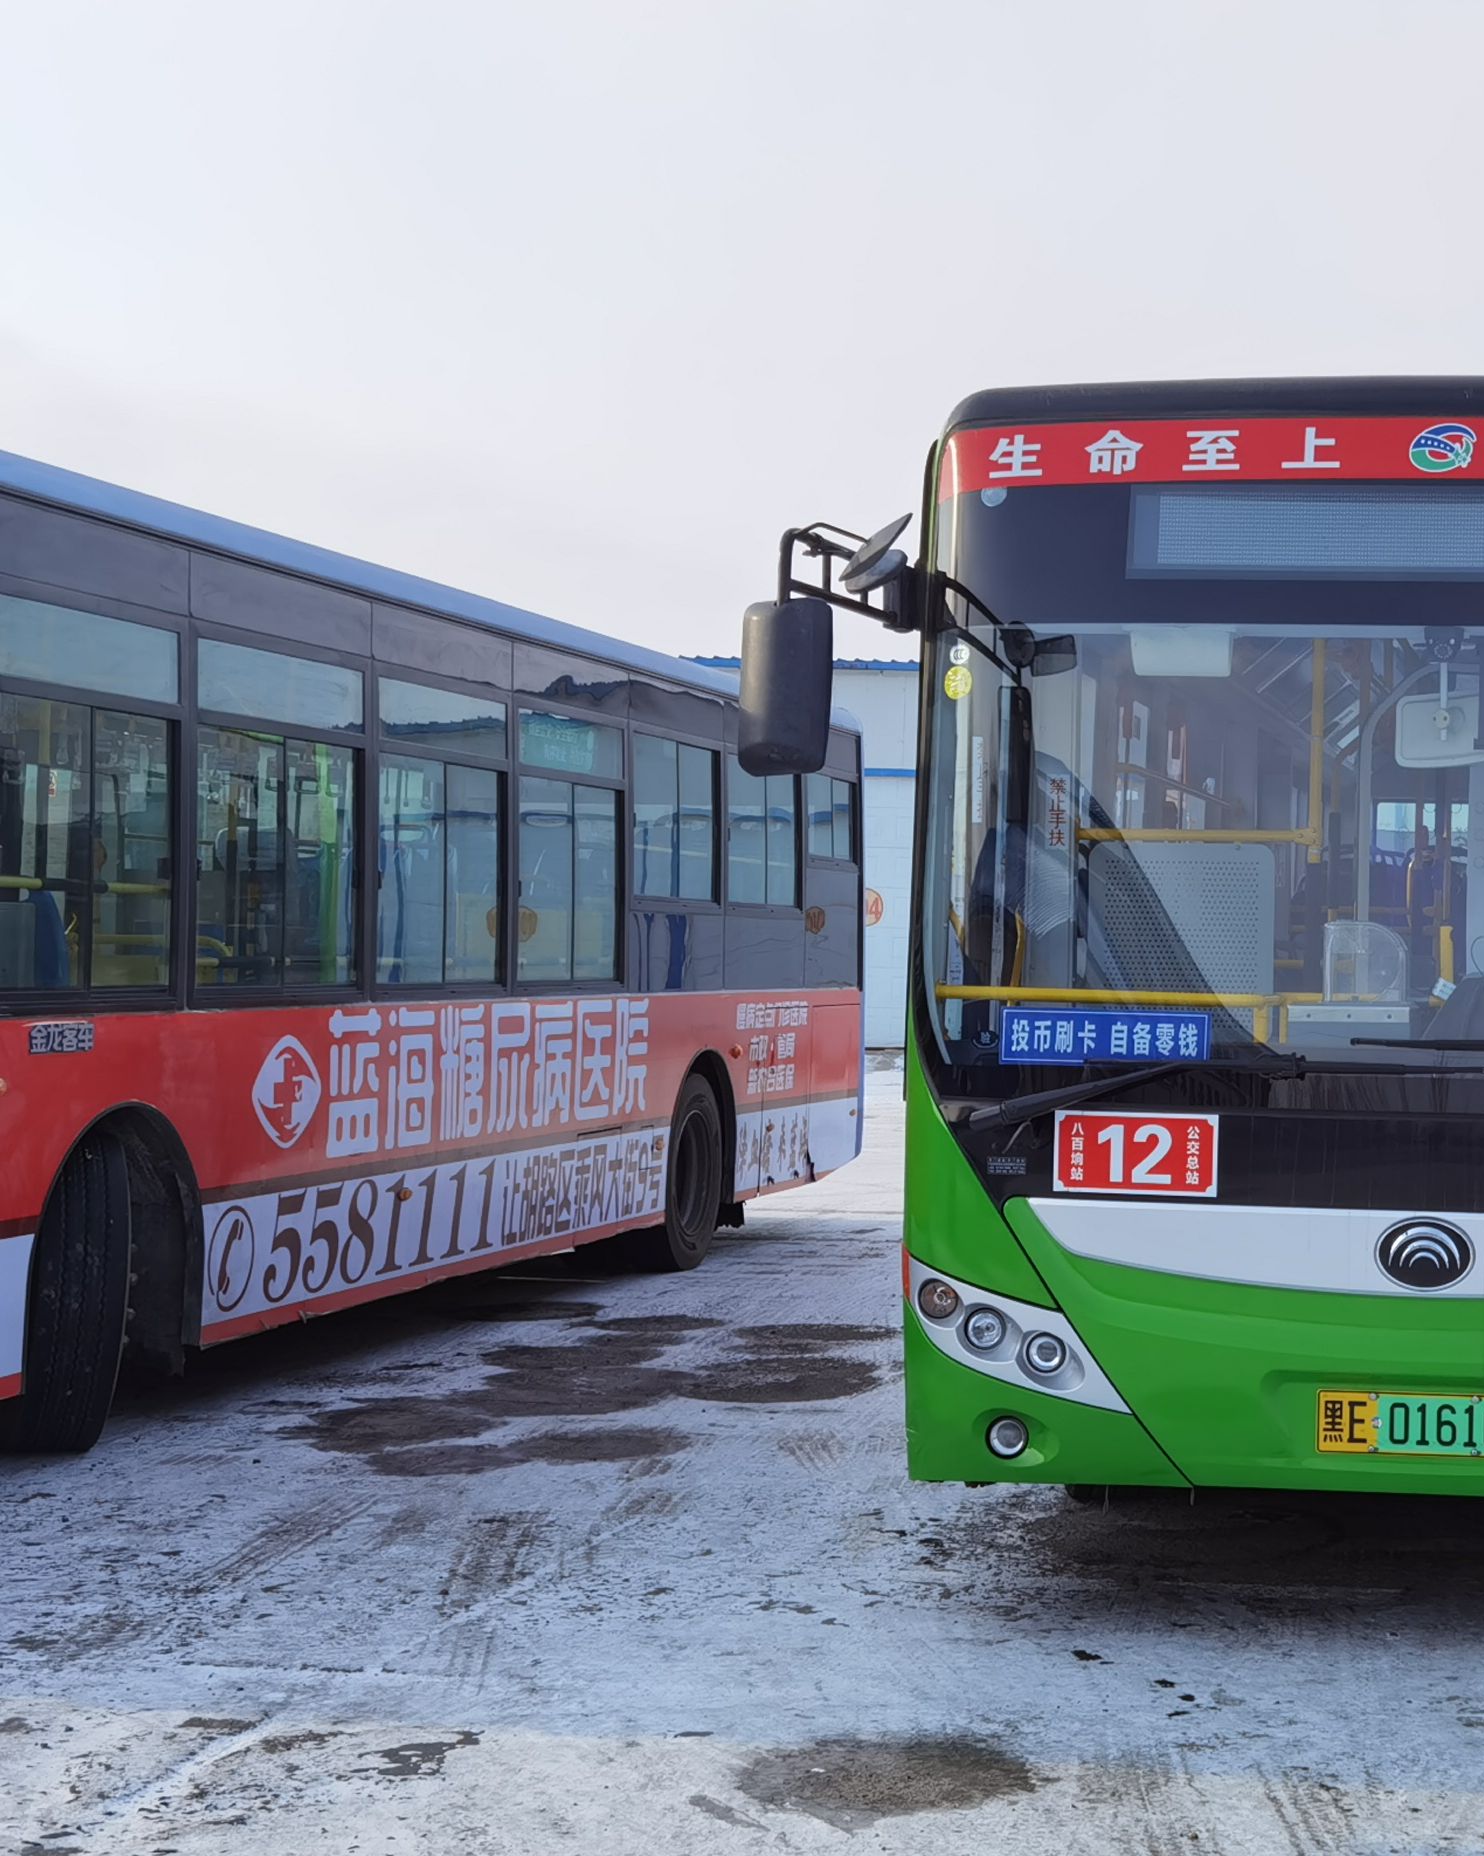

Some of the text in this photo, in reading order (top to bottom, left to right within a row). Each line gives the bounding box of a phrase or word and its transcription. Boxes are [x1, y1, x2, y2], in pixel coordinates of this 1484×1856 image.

[988, 427, 1341, 479] 生命至上
[1048, 777, 1067, 847] 禁止手扶
[30, 1023, 94, 1053] 金龙客车
[1011, 1018, 1199, 1057] 投币刷卡 自备零钱
[326, 998, 649, 1159] 蓝海糖尿病医院
[1070, 1122, 1084, 1181] 八百垧站
[1098, 1124, 1172, 1185] 12
[1186, 1126, 1200, 1184] 公交总站
[502, 1135, 664, 1246] 让胡路区乘风大街9号
[263, 1159, 496, 1303] 5581111
